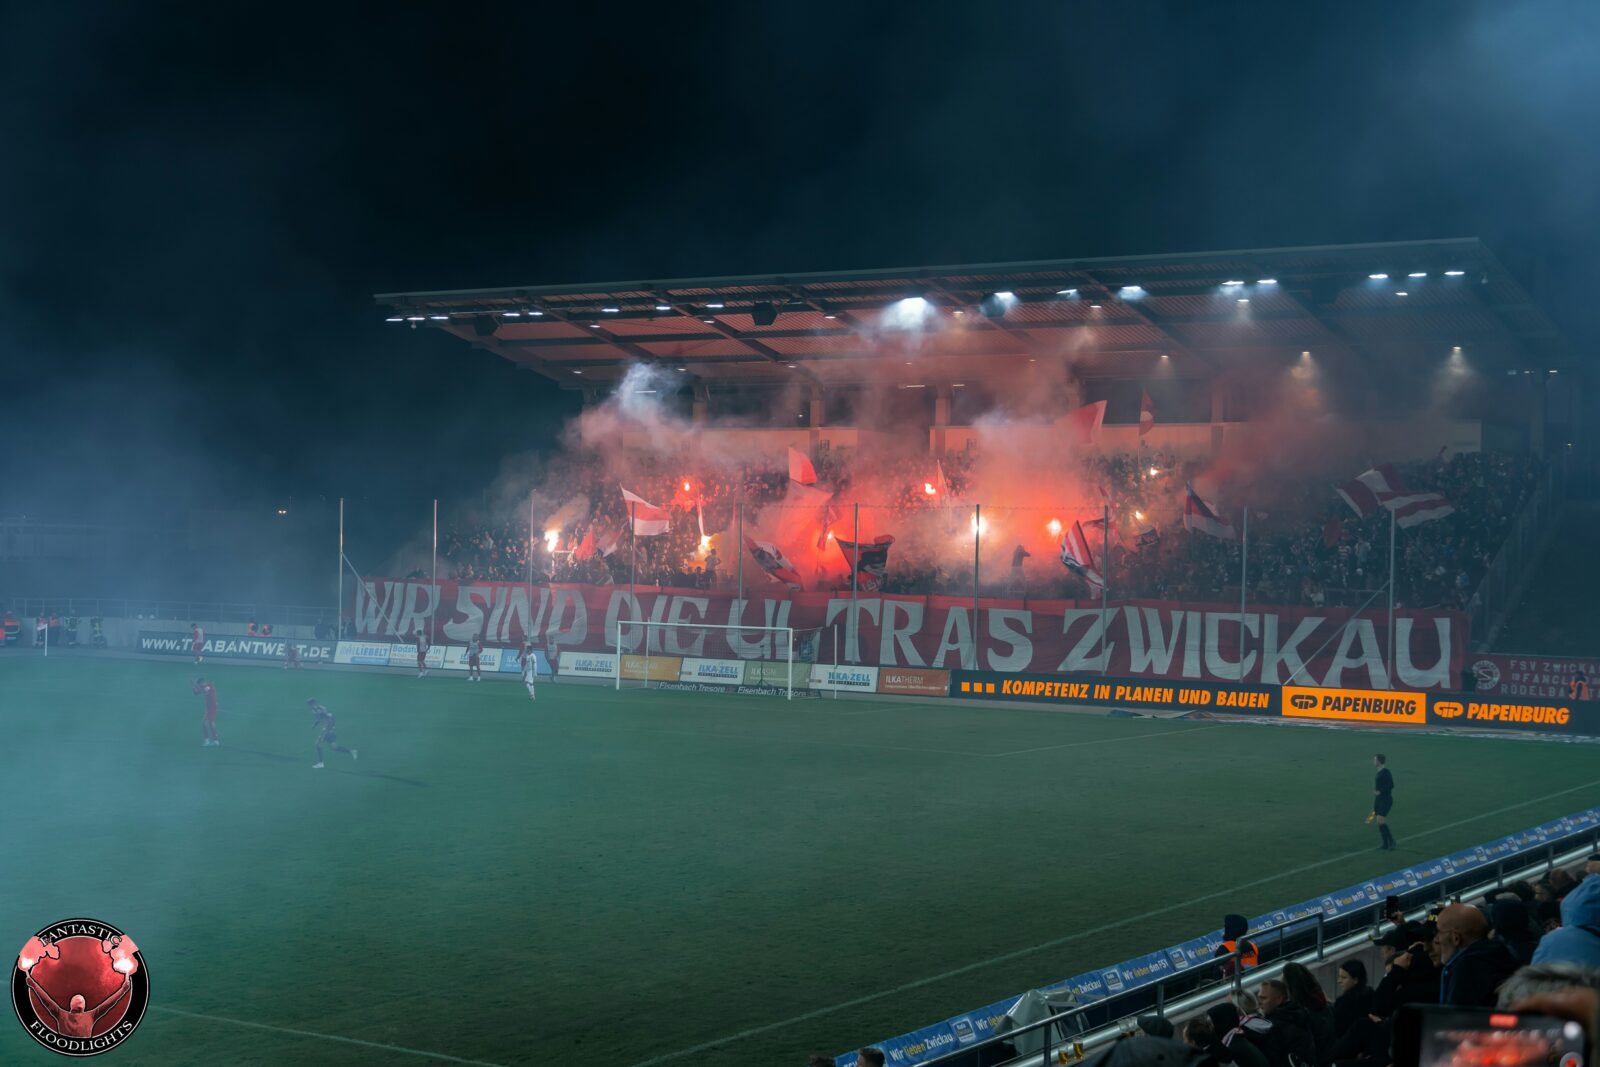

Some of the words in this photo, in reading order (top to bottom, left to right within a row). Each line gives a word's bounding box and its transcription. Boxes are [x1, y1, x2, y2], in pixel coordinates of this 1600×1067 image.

[355, 581, 441, 637] WIR
[443, 586, 588, 645] SIND
[604, 590, 709, 656] DIE
[726, 597, 1033, 672] ULTRAS
[1057, 605, 1450, 689] ZWICKAU
[141, 637, 331, 659] WWW.TABANTWET.DE
[1510, 660, 1538, 670] FSV
[1543, 662, 1600, 674] ZWICKA
[659, 682, 697, 691] Eisenbach
[737, 687, 776, 696] Eisenbach
[1002, 680, 1089, 699] KOMPETENZ
[1093, 685, 1111, 700] IN
[1115, 686, 1174, 704] PLANEN
[1178, 689, 1212, 706] UND
[1216, 691, 1270, 709] BAUEN
[1322, 695, 1417, 716] PAPENBURG
[1467, 703, 1571, 726] PAPENBURG
[1122, 969, 1135, 981] Wir
[975, 1018, 989, 1031] Wir
[889, 1048, 904, 1062] Wir
[904, 1041, 927, 1057] lieben
[924, 1031, 955, 1050] Zwickau
